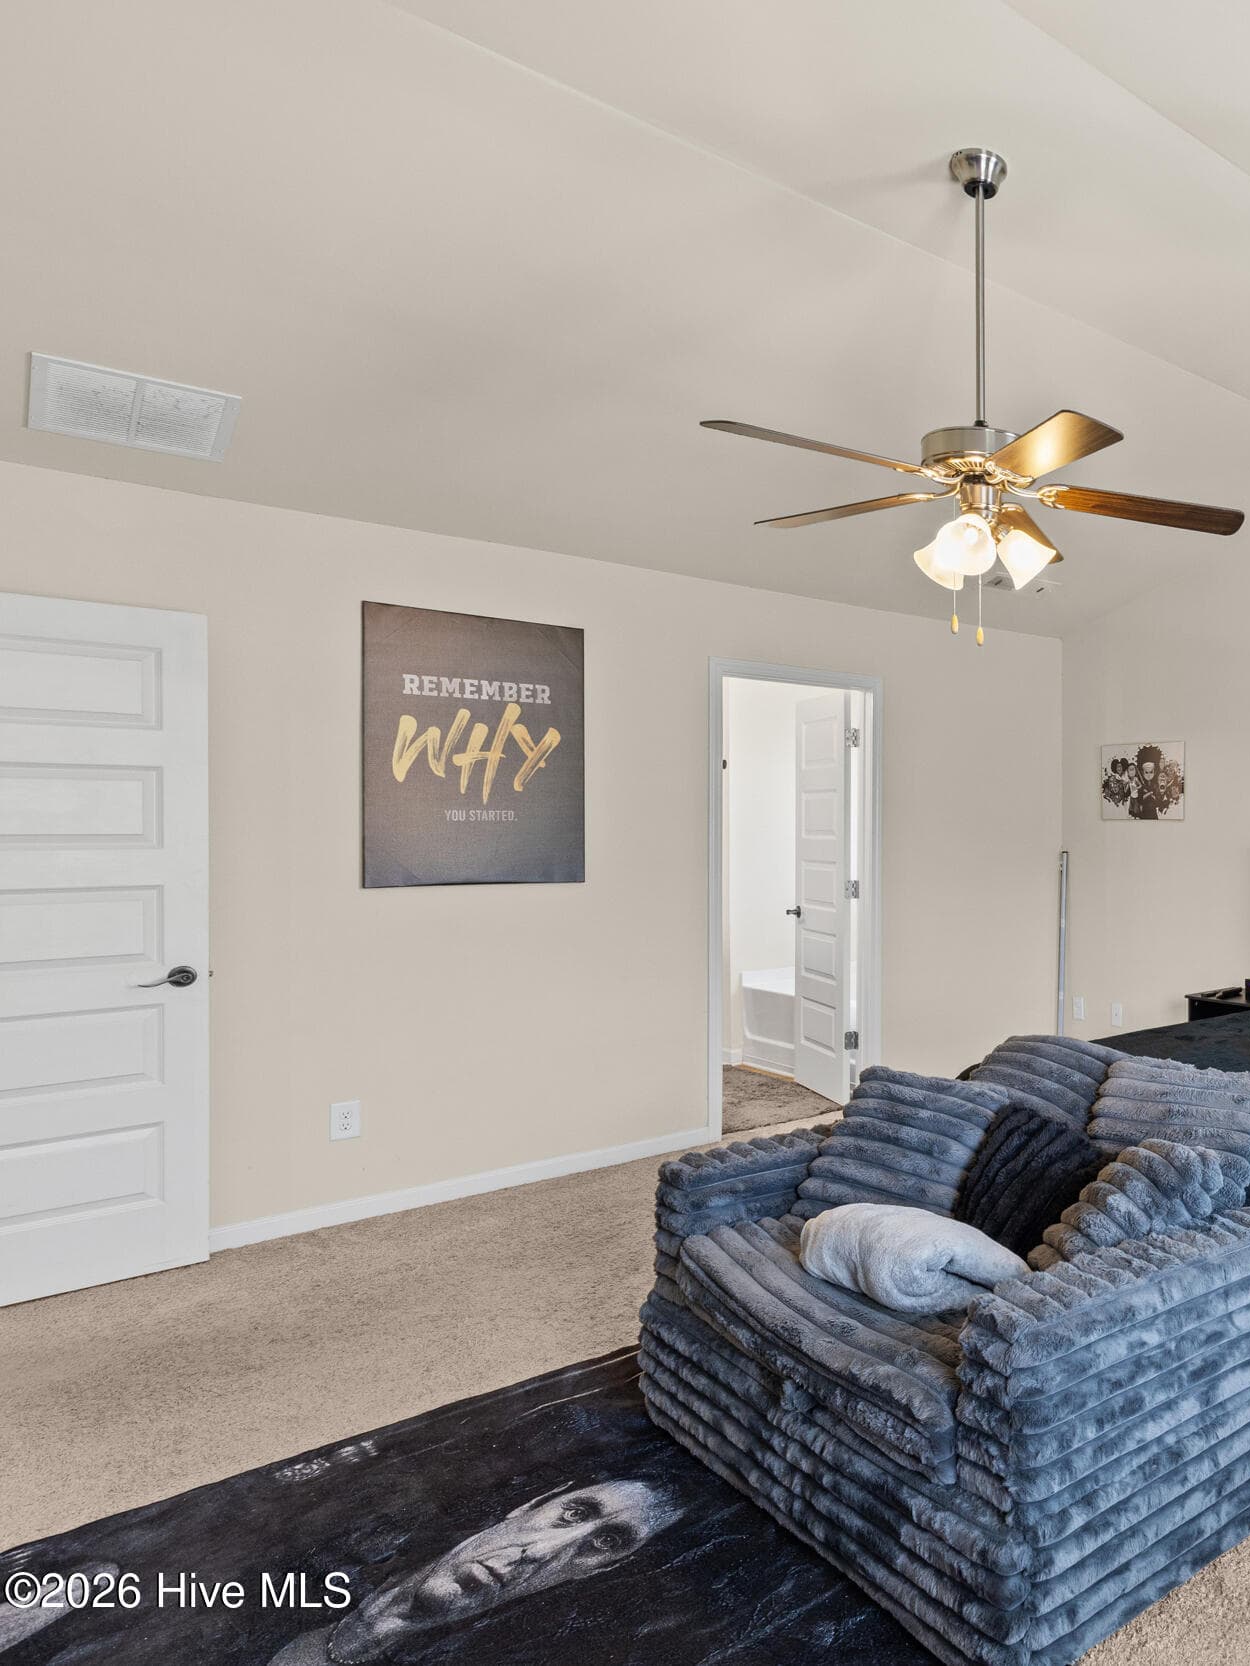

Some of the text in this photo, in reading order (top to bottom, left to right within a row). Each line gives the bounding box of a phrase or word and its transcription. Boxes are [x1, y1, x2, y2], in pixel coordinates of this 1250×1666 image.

[402, 674, 552, 704] REMEMBER
[392, 702, 561, 805] WHY
[444, 809, 518, 822] YOU STARTED.
